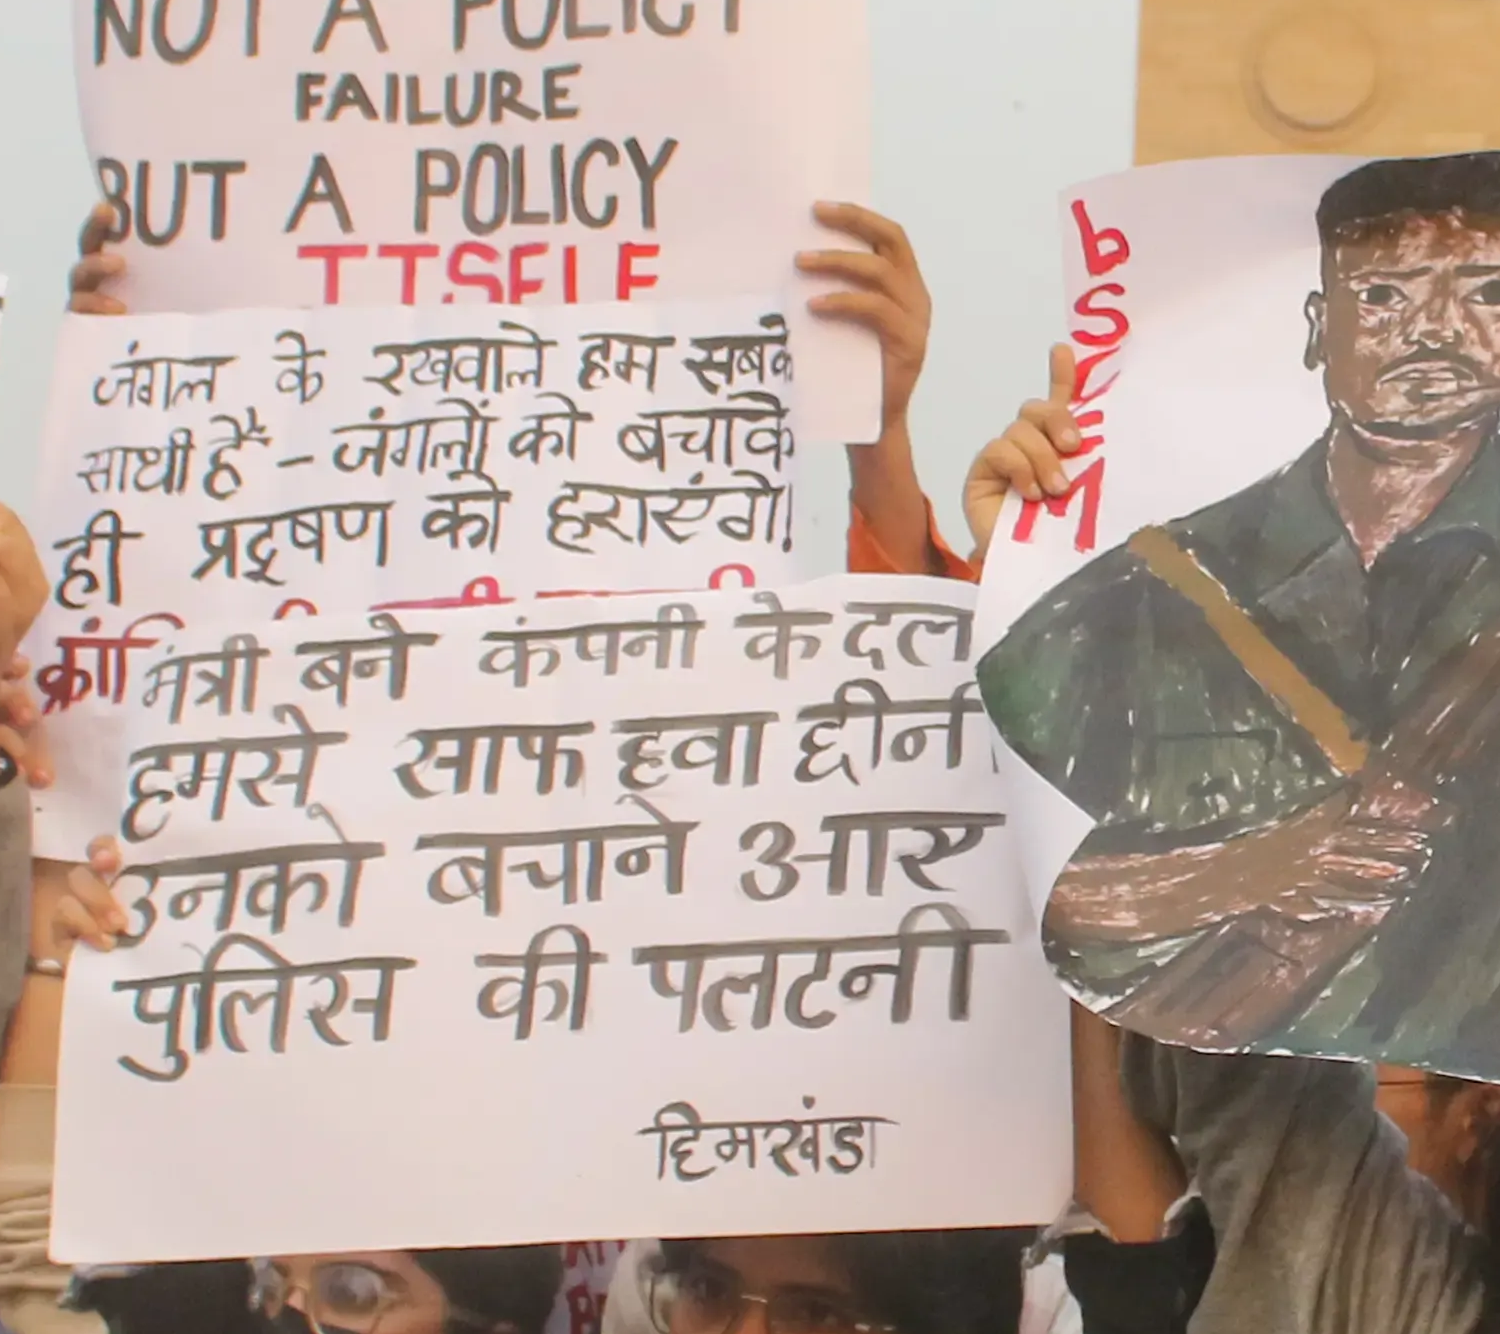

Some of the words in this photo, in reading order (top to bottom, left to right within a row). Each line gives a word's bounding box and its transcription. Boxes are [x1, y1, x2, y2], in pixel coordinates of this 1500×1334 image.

[294, 64, 583, 126] FAILURE
[94, 157, 246, 247] BUT
[284, 153, 355, 234] A
[414, 137, 679, 237] POLICY
[92, 339, 238, 412] जंगल
[272, 327, 327, 405] के
[363, 319, 558, 395] रखवाले
[577, 331, 677, 393] हम
[507, 390, 595, 467] को
[52, 508, 145, 612] ही
[421, 469, 513, 555] को
[295, 611, 444, 709] बने
[478, 601, 708, 689] कंपनी
[733, 590, 835, 680] के
[122, 703, 350, 843] हमसे
[393, 722, 596, 799] साफ
[610, 710, 782, 793] हवा
[414, 792, 702, 917] बचाने
[111, 932, 420, 1083] पुलिस
[472, 923, 610, 1042] की
